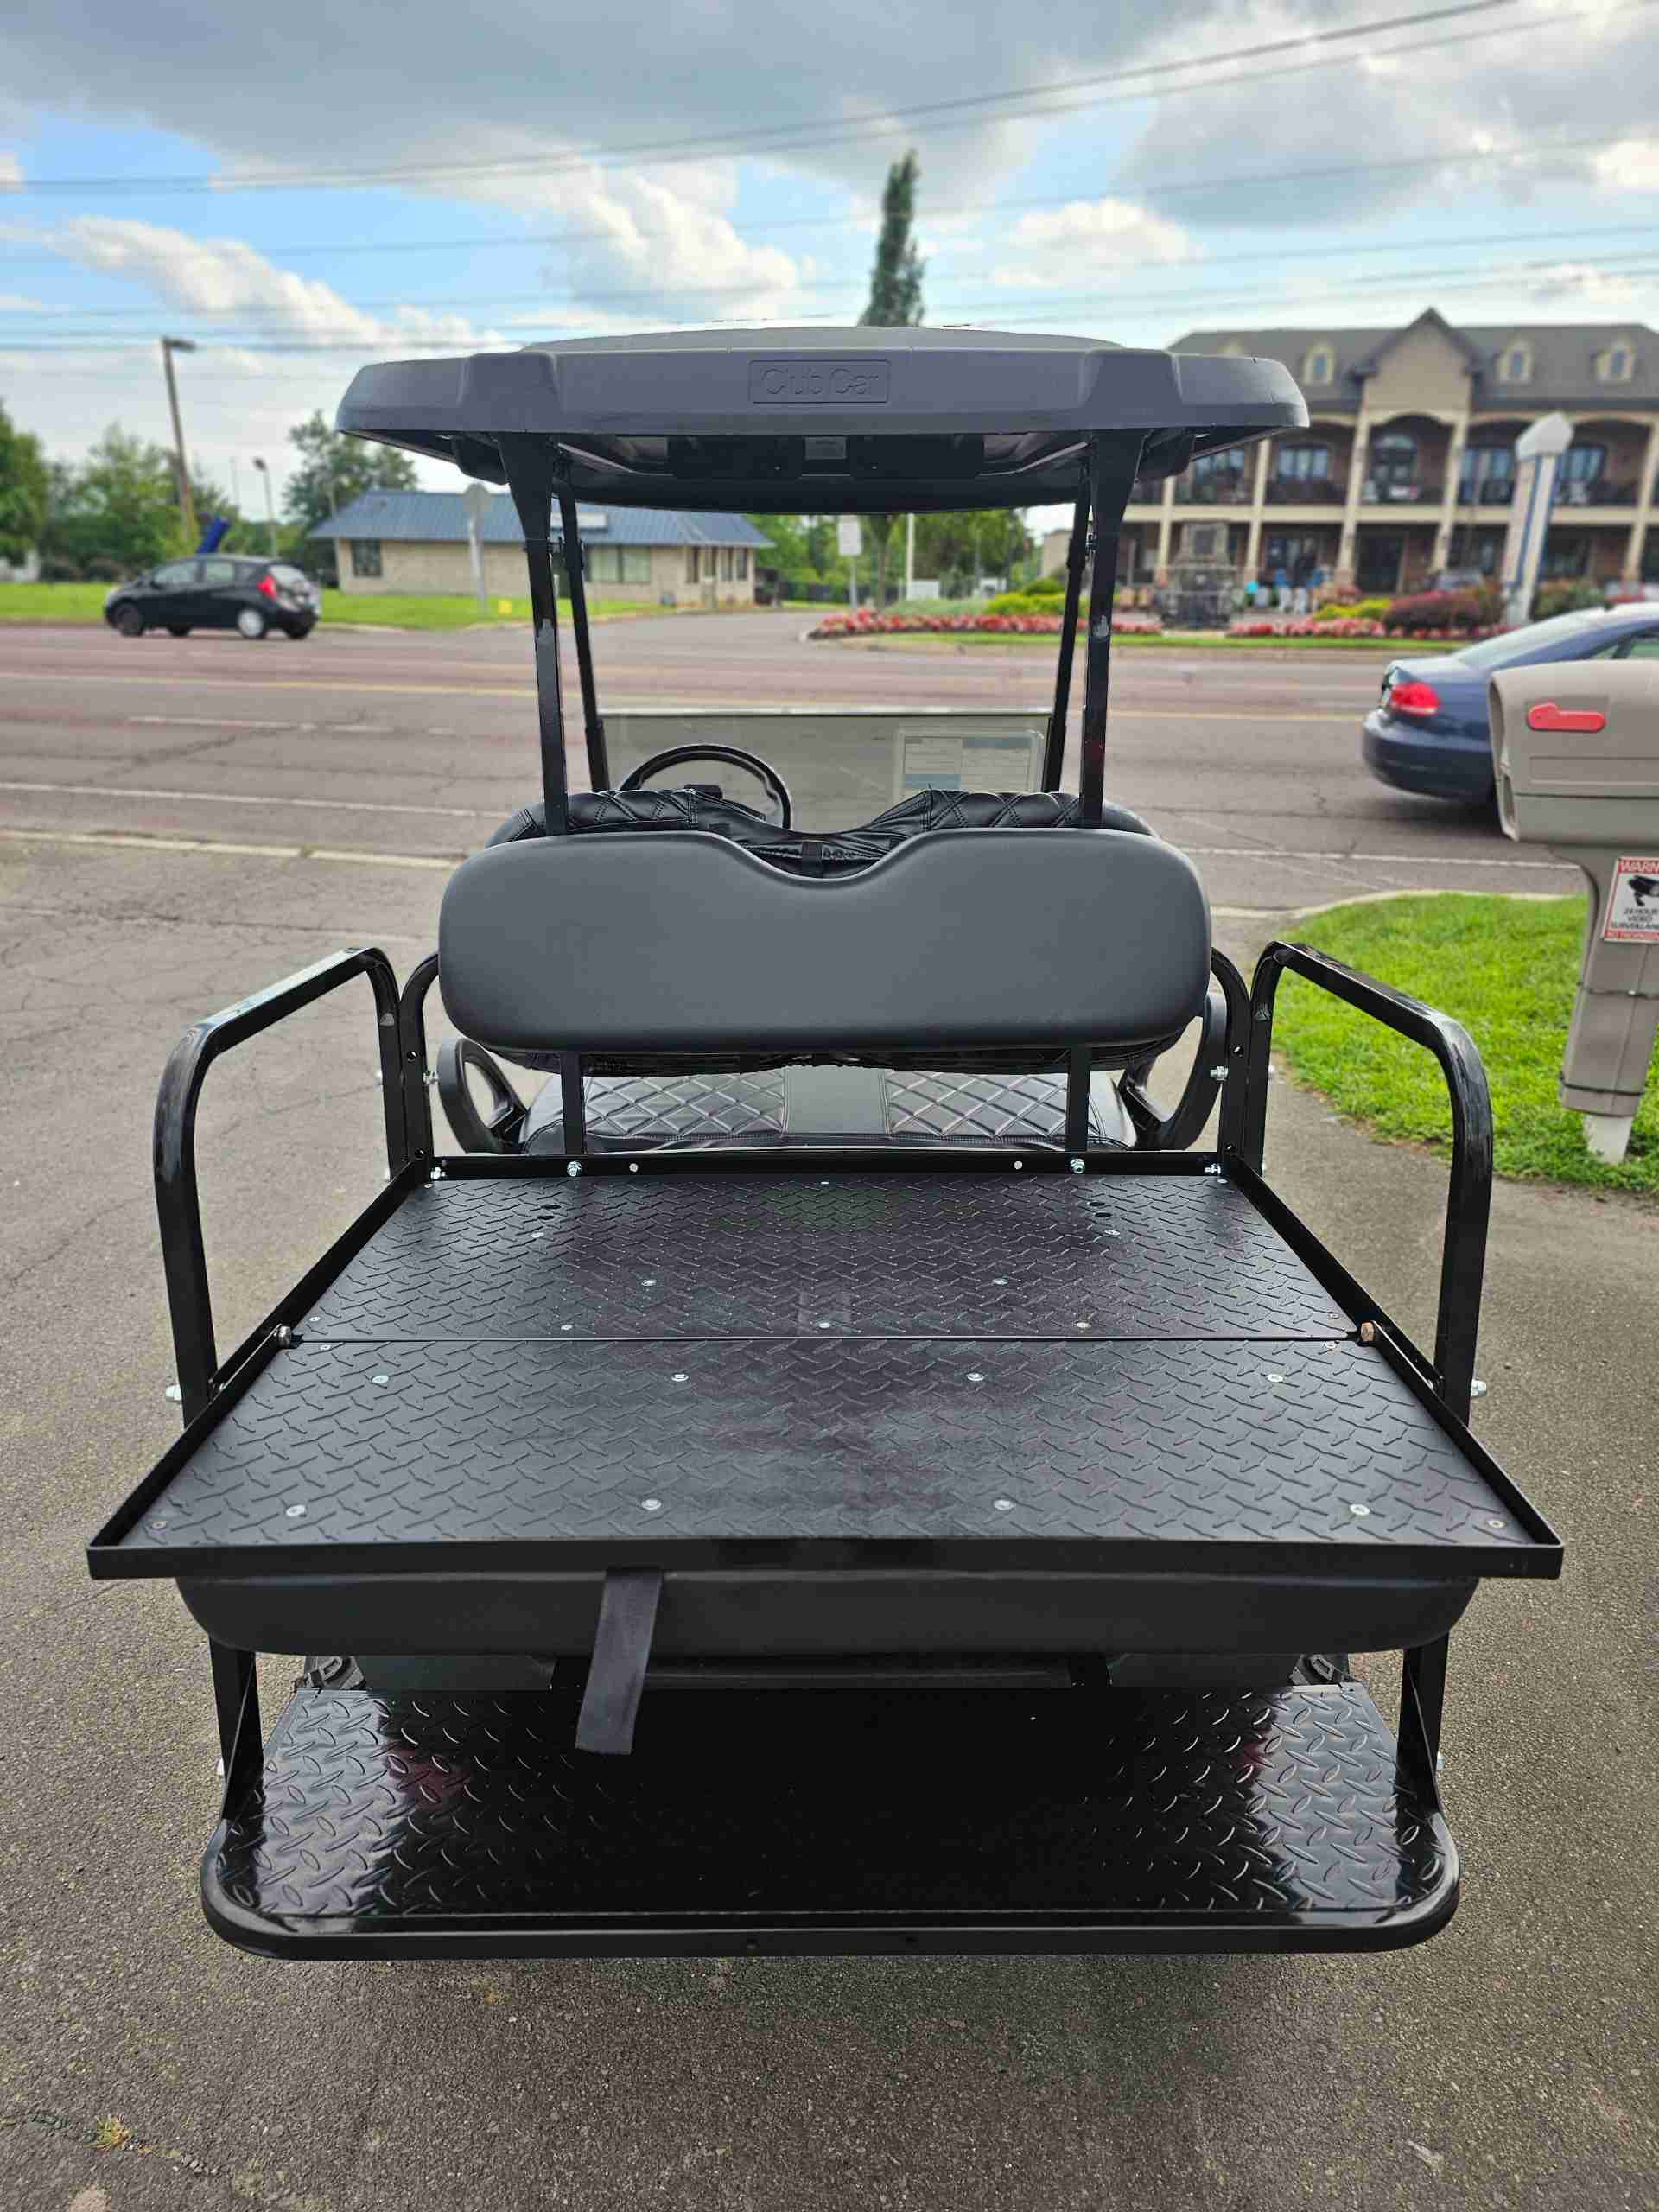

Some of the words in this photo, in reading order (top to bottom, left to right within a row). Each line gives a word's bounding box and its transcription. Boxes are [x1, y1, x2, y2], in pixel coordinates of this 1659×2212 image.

[761, 366, 823, 395] Club
[830, 366, 879, 395] Car
[1620, 861, 1659, 873] WARN
